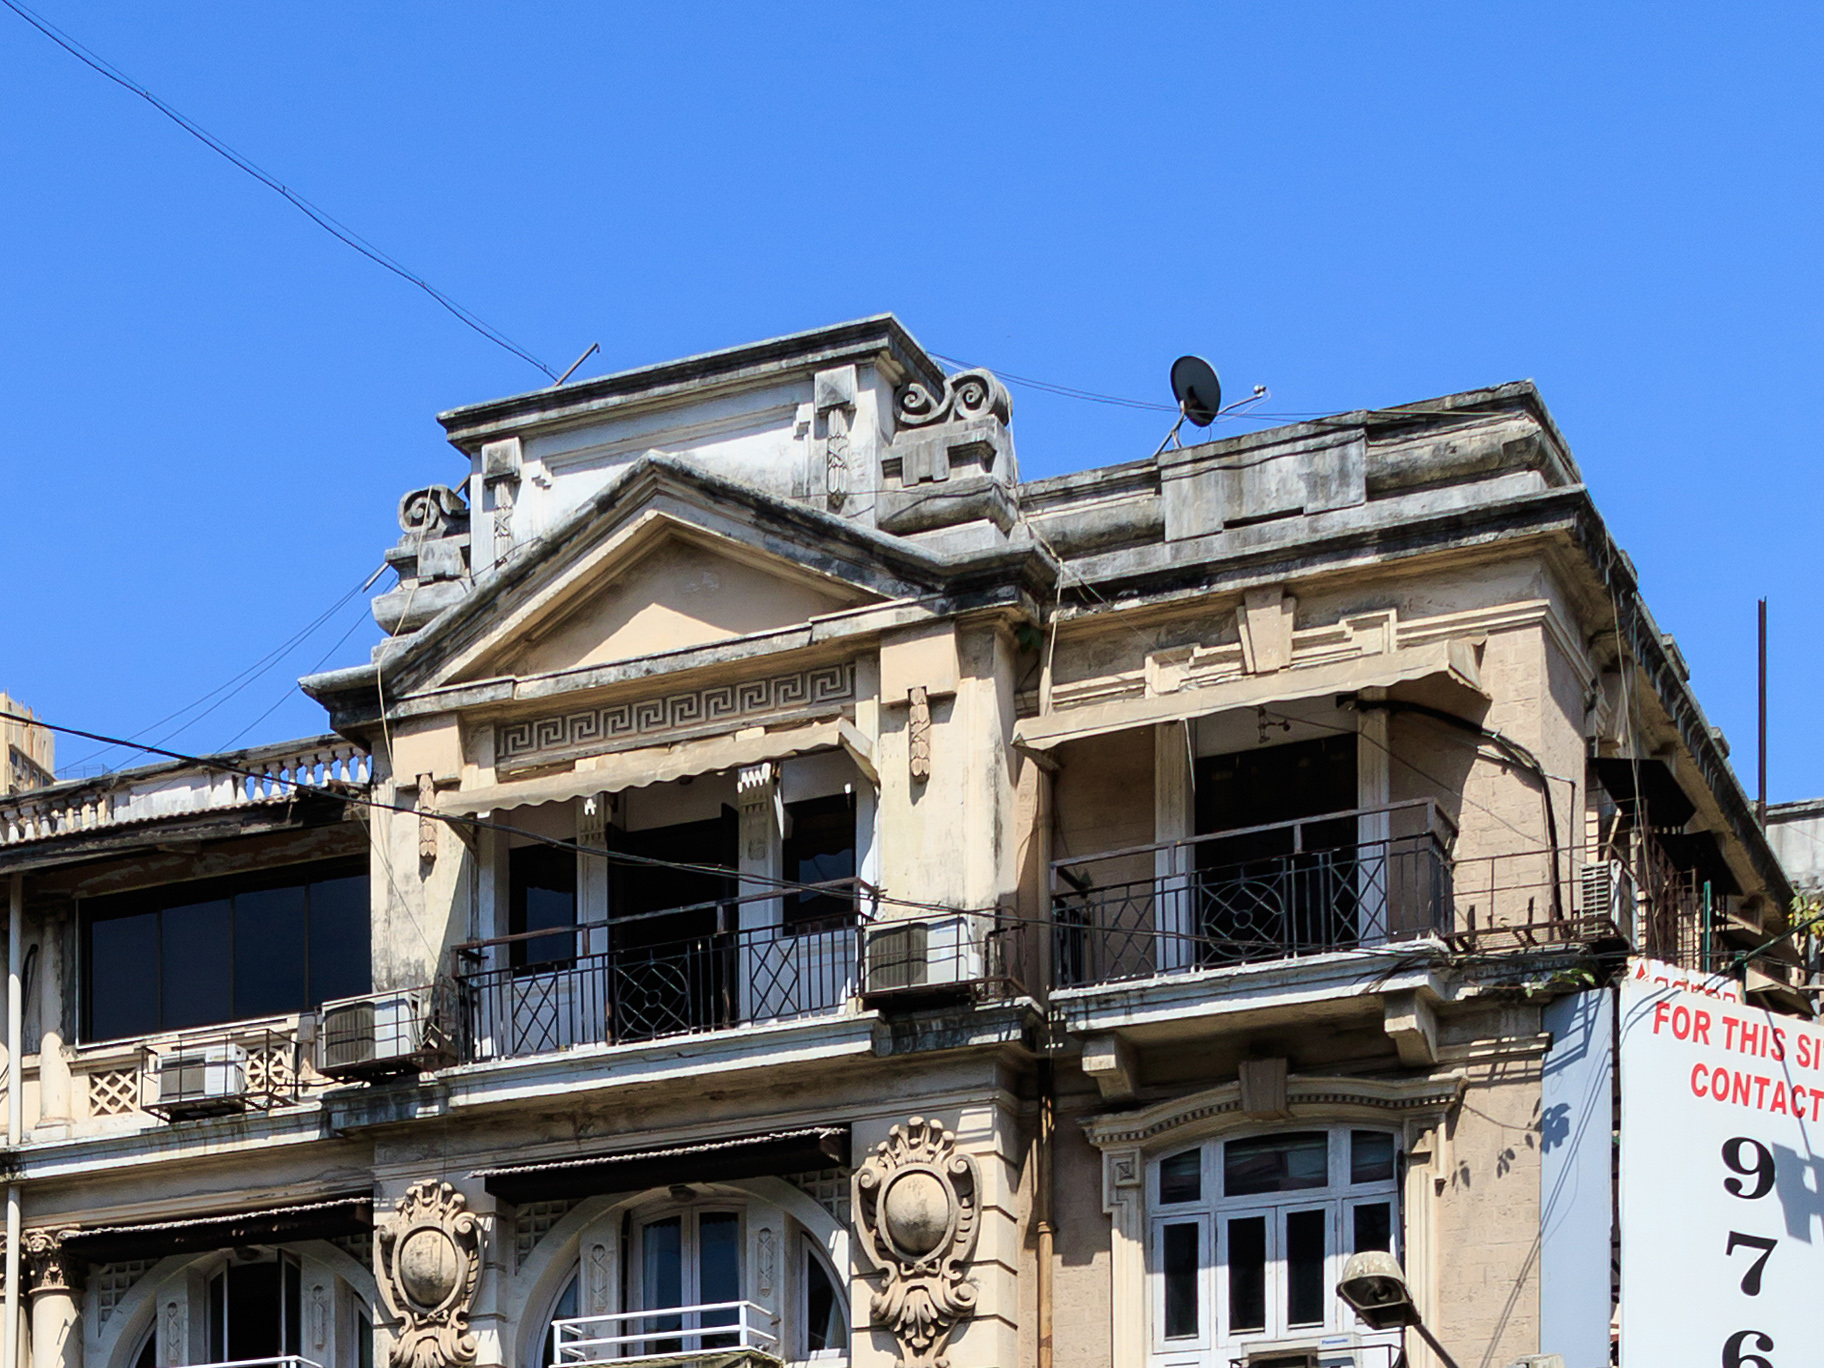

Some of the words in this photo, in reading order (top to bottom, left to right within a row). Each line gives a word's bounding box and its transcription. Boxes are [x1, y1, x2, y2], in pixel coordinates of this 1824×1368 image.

[1653, 1001, 1710, 1045] FOR
[1723, 1017, 1786, 1062] THIS
[1691, 1063, 1824, 1122] CONTACT
